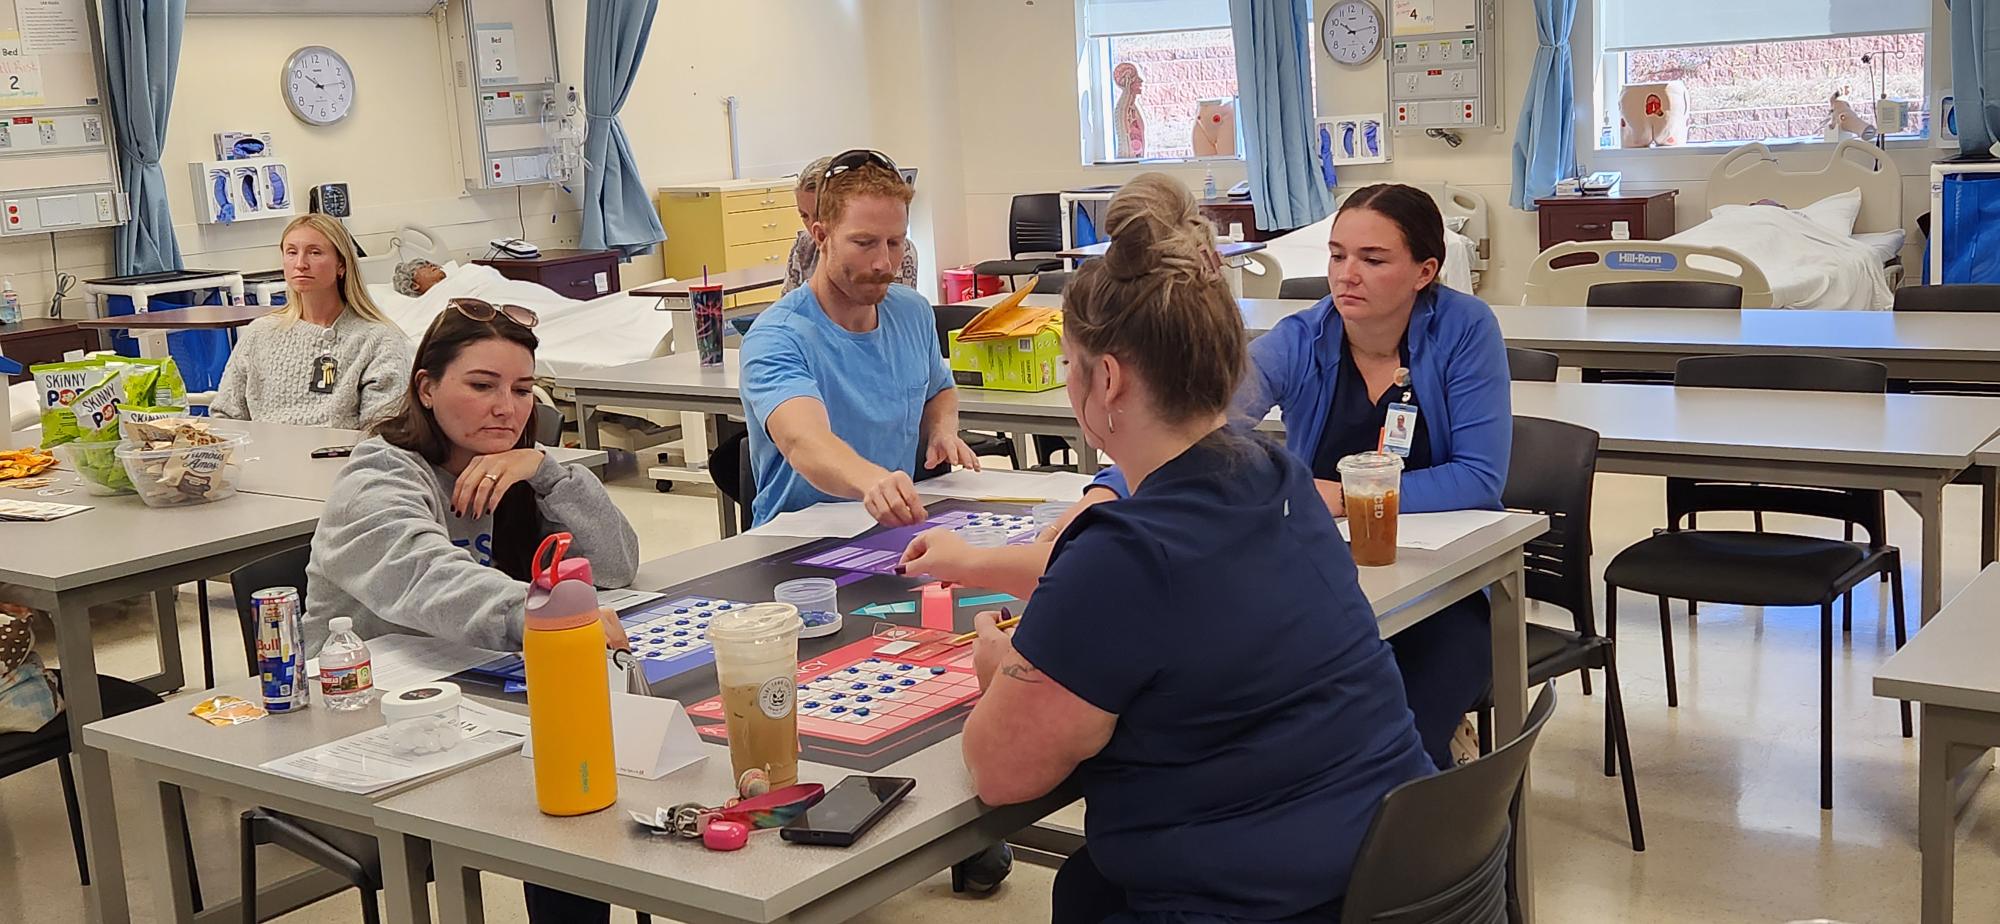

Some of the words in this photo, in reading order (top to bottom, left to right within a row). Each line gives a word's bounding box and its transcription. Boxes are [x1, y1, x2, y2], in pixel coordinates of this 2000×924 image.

[1410, 8, 1418, 20] 4
[2, 48, 18, 56] Bed
[311, 54, 320, 64] 12
[495, 59, 502, 72] 3
[9, 75, 20, 90] 2
[1618, 252, 1662, 264] Hill-Rom
[256, 638, 280, 651] Bull
